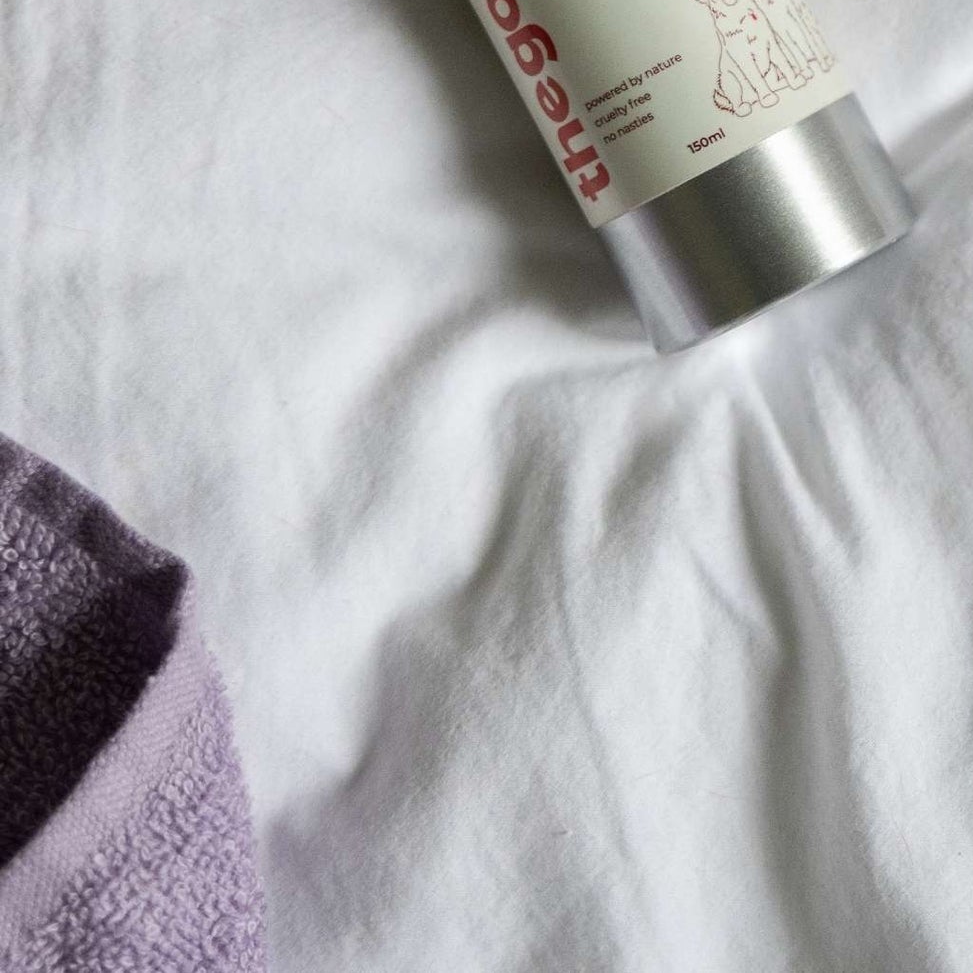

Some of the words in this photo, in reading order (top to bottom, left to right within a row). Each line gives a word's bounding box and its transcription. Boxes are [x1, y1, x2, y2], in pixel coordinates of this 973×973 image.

[584, 80, 629, 112] powered
[628, 73, 643, 87] by
[644, 54, 683, 79] nature
[594, 103, 628, 128] cruelty
[628, 92, 652, 110] free
[602, 132, 617, 145] no
[617, 112, 655, 138] nasties
[686, 127, 726, 154] 150ml
